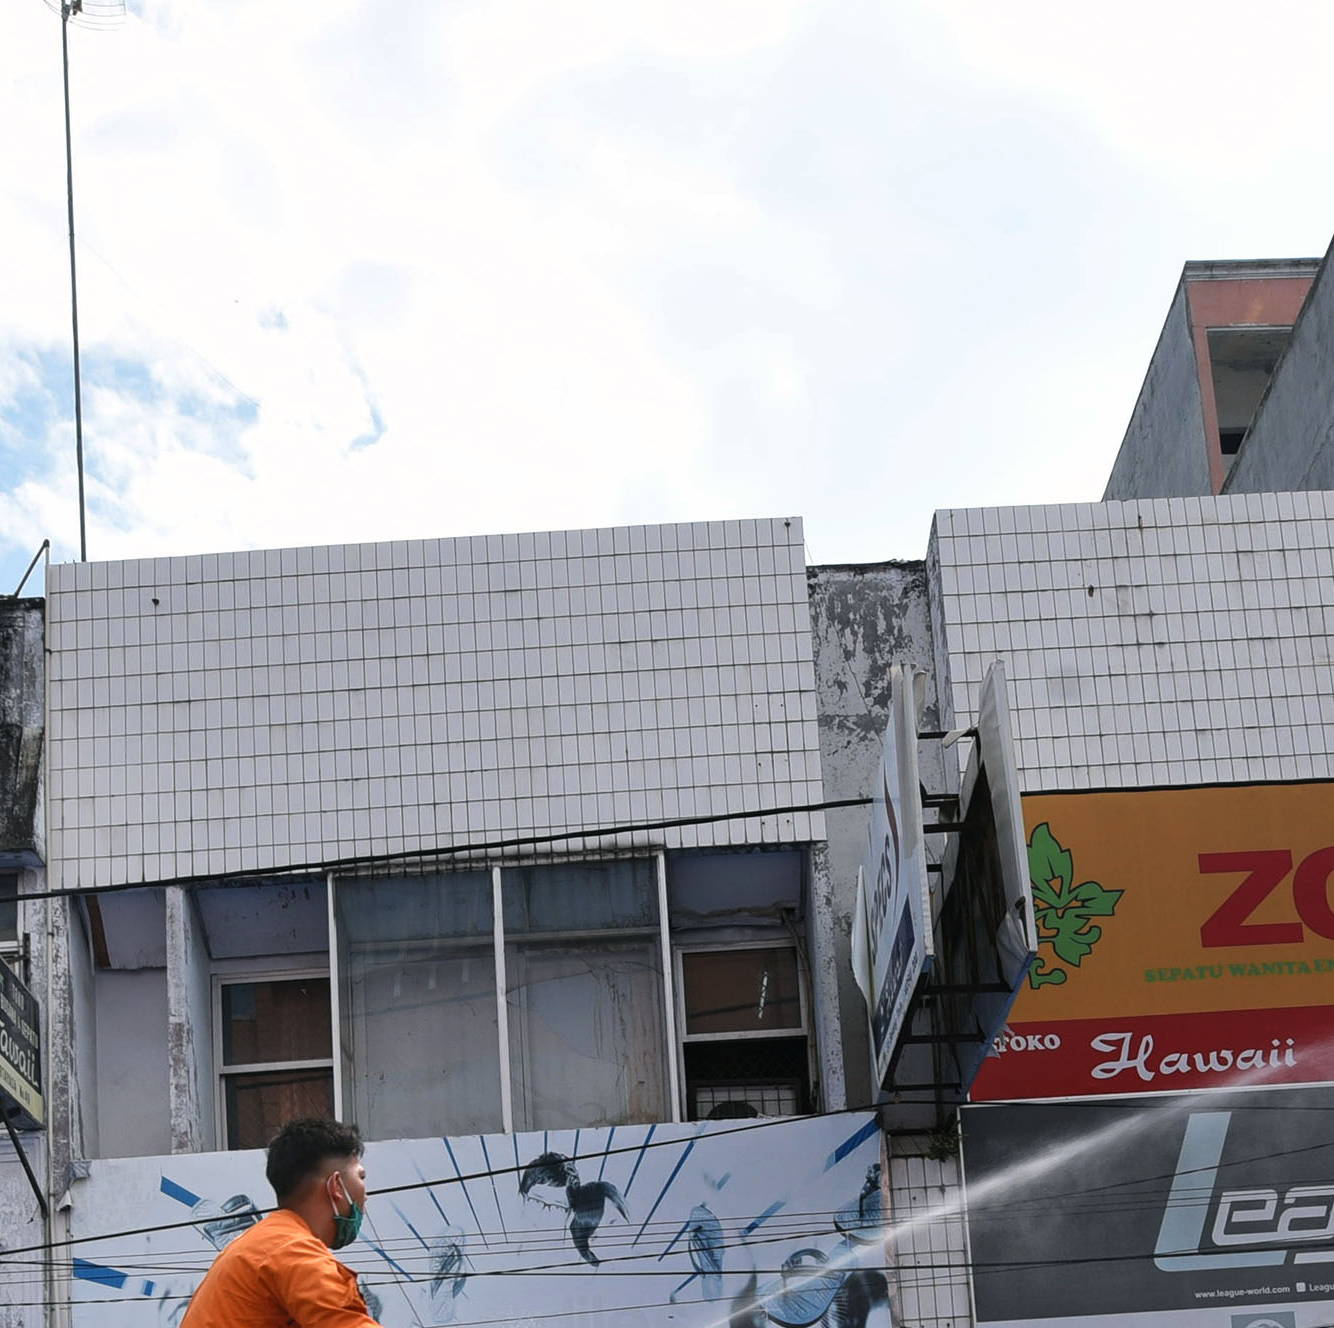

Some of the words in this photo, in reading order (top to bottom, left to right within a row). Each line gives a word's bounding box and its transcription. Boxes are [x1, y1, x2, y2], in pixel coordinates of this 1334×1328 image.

[1143, 965, 1224, 983] SEPATU
[1229, 960, 1311, 978] WANITA
[1090, 1032, 1298, 1082] Hawaii
[1194, 1284, 1291, 1299] www.league-world.com
